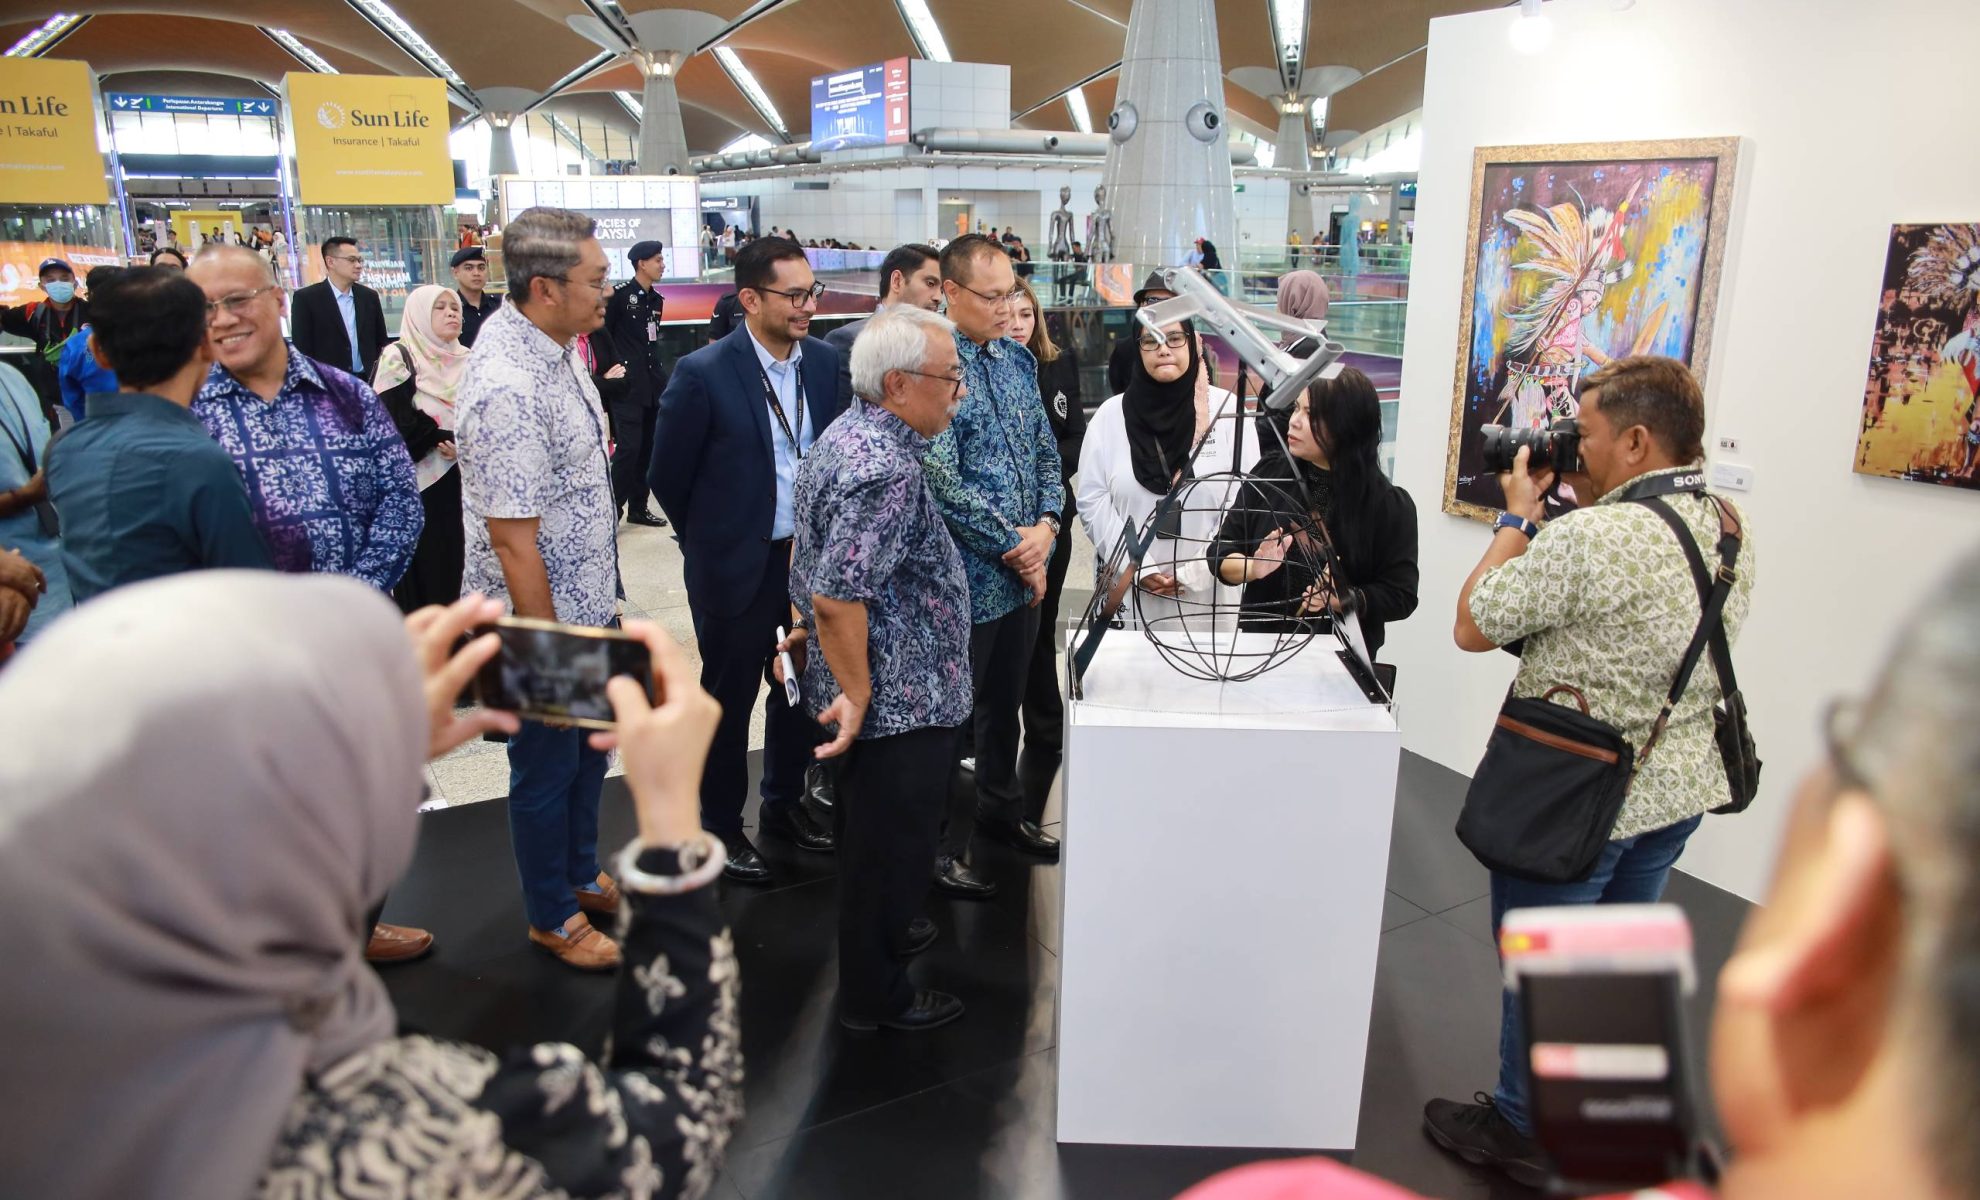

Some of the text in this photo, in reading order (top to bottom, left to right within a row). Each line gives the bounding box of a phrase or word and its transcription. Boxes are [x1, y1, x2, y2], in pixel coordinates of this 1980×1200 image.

[21, 96, 69, 117] Life
[351, 109, 430, 128] Sun Life
[15, 126, 59, 138] Takaful
[333, 137, 378, 146] Insurance
[387, 137, 420, 147] Takaful
[628, 218, 641, 228] OF
